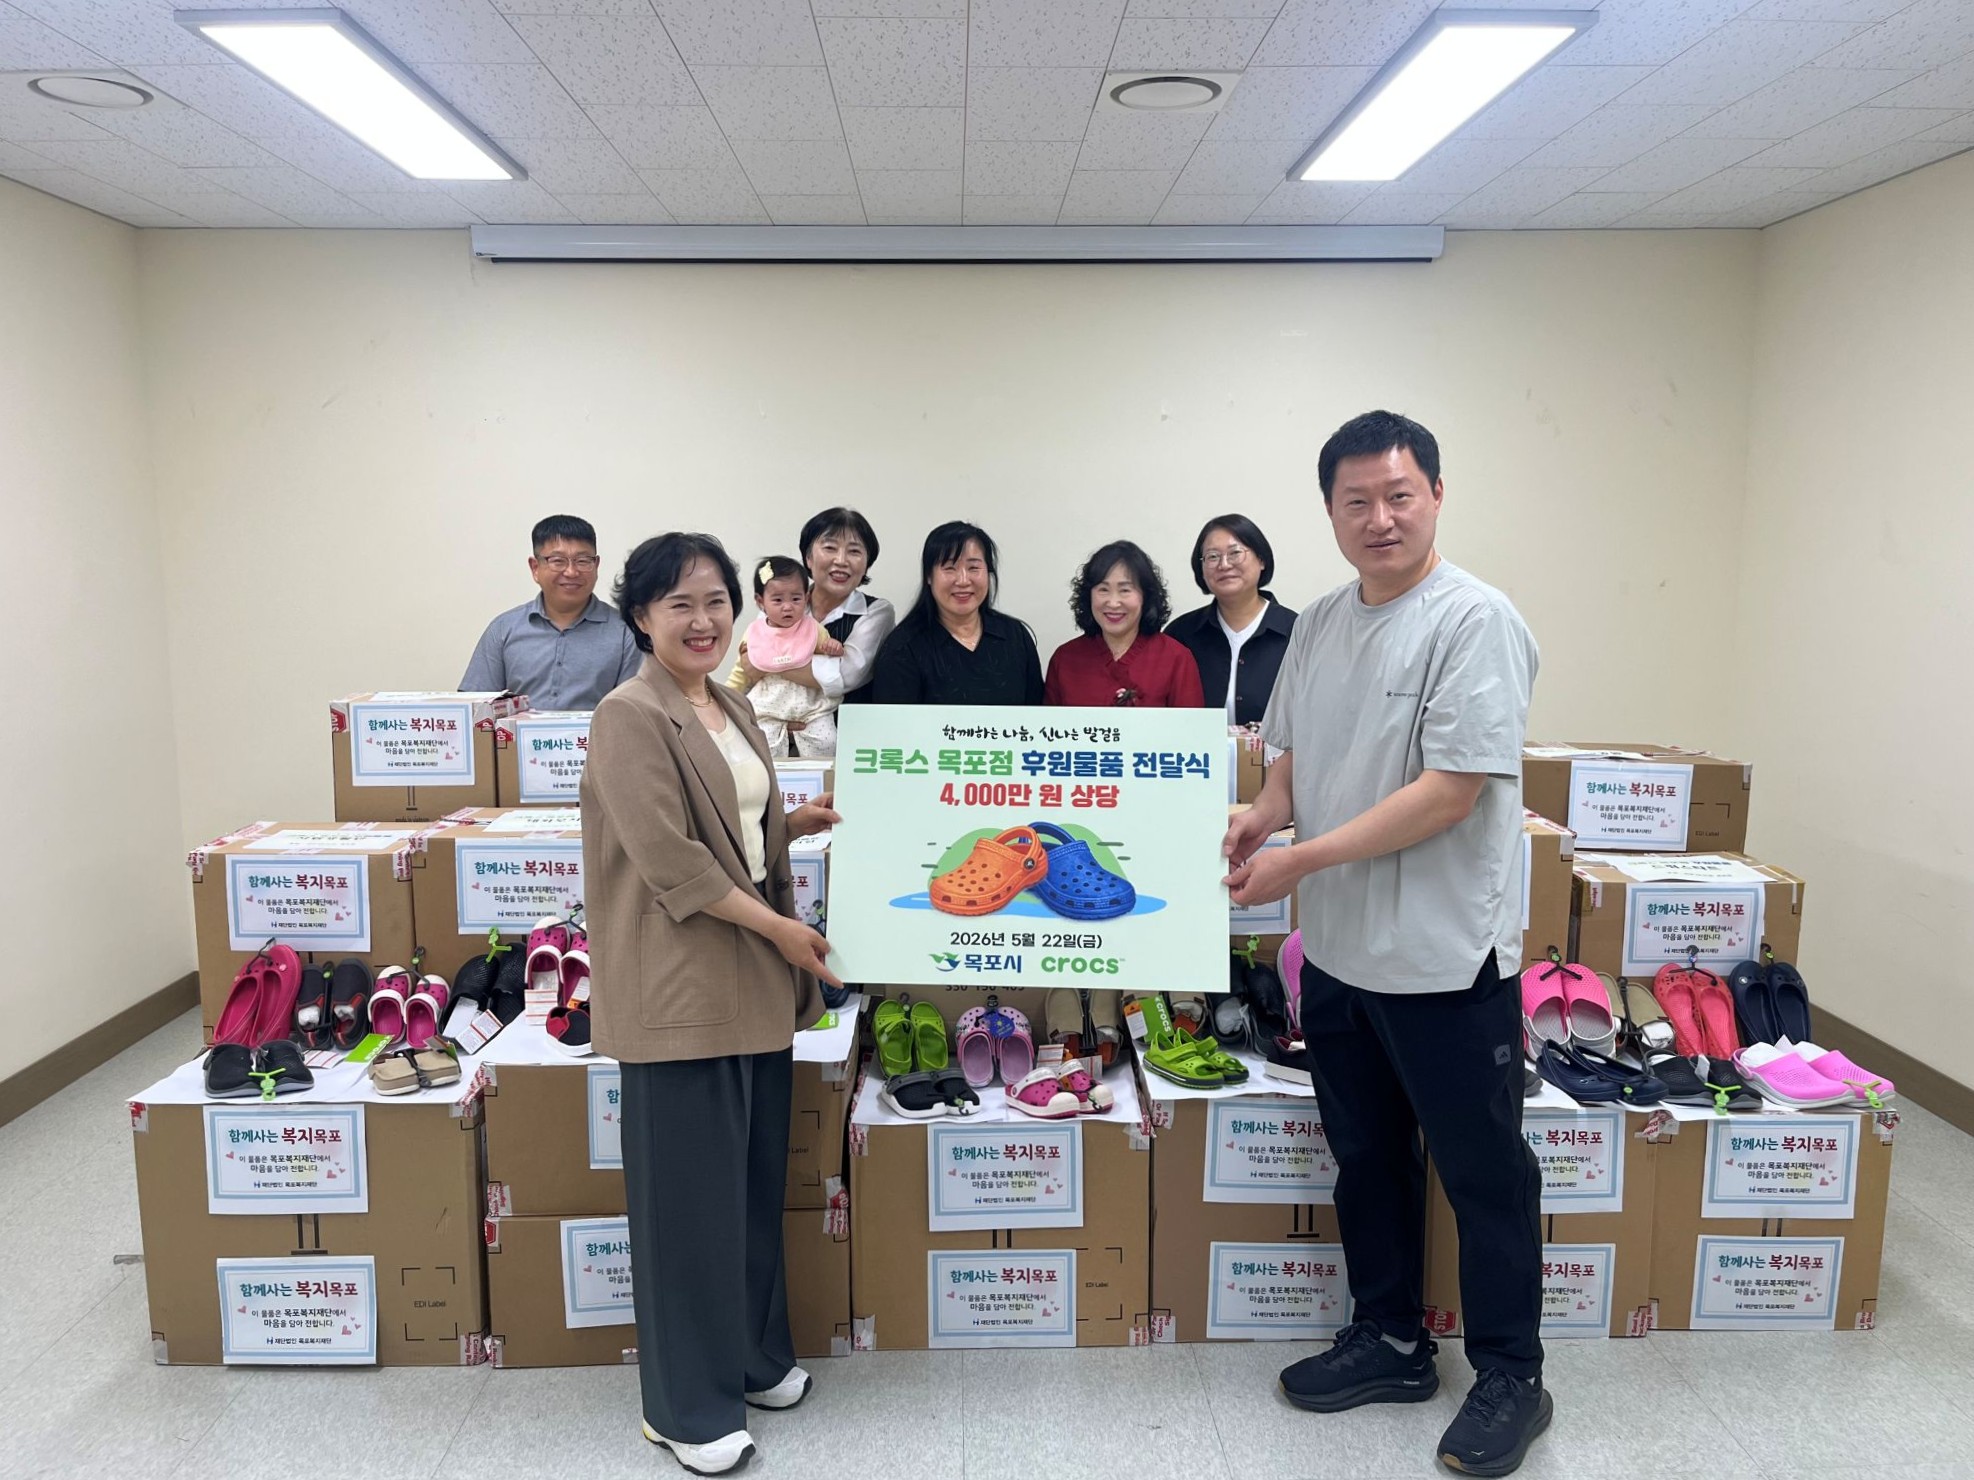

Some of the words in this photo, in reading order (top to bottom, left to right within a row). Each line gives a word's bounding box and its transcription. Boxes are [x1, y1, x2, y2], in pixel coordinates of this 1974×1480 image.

[368, 720, 408, 731] 함께사는
[410, 718, 457, 732] 복지목포
[943, 725, 998, 740] 함께하는
[1003, 726, 1034, 741] 나눔,
[1039, 726, 1079, 741] 신나는
[1083, 726, 1121, 742] 발걸음
[532, 739, 574, 750] 함께사는
[853, 749, 929, 776] 크록스
[938, 749, 1014, 777] 목포점
[1021, 750, 1124, 778] 후원물품
[1132, 752, 1211, 779] 전달식
[1039, 784, 1062, 808] 원
[1070, 785, 1120, 809] 상당
[1587, 782, 1627, 795] 함께사는
[1629, 782, 1676, 797] 복지목포
[474, 862, 521, 875] 함께사는
[524, 860, 579, 876] 복지목포
[248, 876, 293, 888] 함께사는
[296, 874, 348, 890] 복지목포
[1648, 904, 1690, 915] 함께사는
[1693, 902, 1744, 916] 복지목포
[950, 932, 1005, 947] 2026년
[1011, 932, 1036, 948] 5월
[1041, 933, 1103, 949] 22일(금)
[964, 954, 1023, 974] 목포시
[1041, 956, 1119, 974] crocs
[1156, 1003, 1171, 1032] crocs
[1231, 1120, 1279, 1135] 함께사는
[228, 1130, 278, 1143] 함께사는
[282, 1128, 342, 1144] 복지목포
[1546, 1129, 1603, 1146] 복지목포
[1731, 1138, 1778, 1150] 함께사는
[1781, 1136, 1837, 1152] 복지목포
[270, 1155, 330, 1163] 목포복지재단에서
[952, 1146, 1000, 1160] 함께사는
[1003, 1144, 1060, 1161] 복지목포
[250, 1164, 272, 1173] 마음을
[1768, 1162, 1825, 1170] 목포복지재단에서
[1748, 1171, 1769, 1179] 마음을
[1232, 1262, 1279, 1276] 함께사는
[1282, 1262, 1337, 1277] 복지목포
[1719, 1255, 1766, 1268] 함께사는
[1769, 1255, 1823, 1270] 복지목포
[951, 1270, 998, 1283] 함께사는
[1001, 1268, 1057, 1284] 복지목포
[240, 1284, 292, 1297] 함께사는
[295, 1281, 358, 1298] 복지목포
[284, 1308, 346, 1317] 목포복지재단에서
[264, 1319, 286, 1328] 마음을
